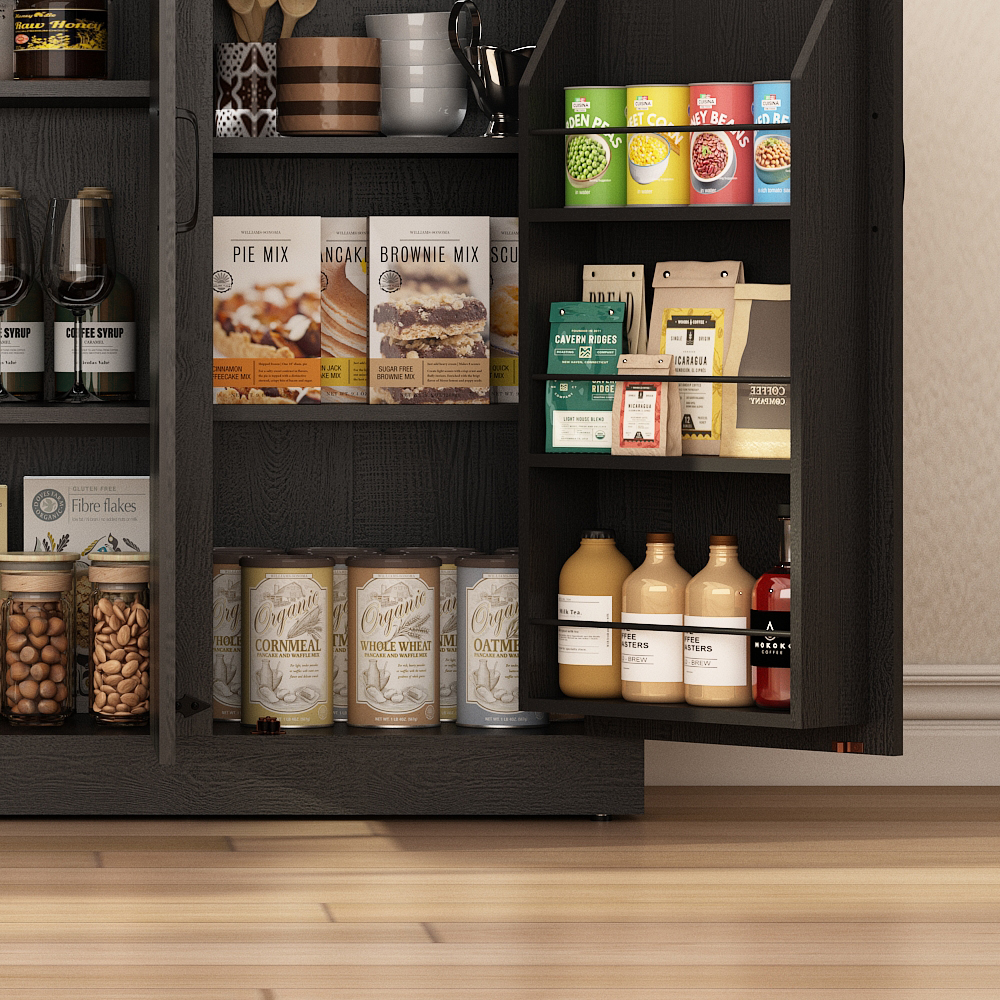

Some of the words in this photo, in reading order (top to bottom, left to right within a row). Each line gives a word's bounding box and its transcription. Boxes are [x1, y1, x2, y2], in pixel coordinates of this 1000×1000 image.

[15, 21, 45, 30] Raw
[49, 20, 103, 31] Honey
[628, 112, 644, 127] EET
[233, 246, 255, 263] PIE
[263, 246, 289, 263] MIX
[321, 246, 367, 263] NCAK
[380, 246, 446, 263] BROWNIE
[454, 246, 479, 263] MIX
[491, 246, 518, 263] SCU
[4, 327, 31, 338] SYRUP
[66, 327, 95, 338] COFEE
[97, 327, 124, 338] SYRUP
[554, 334, 586, 344] CAVERN
[588, 334, 617, 344] RIDGES
[33, 490, 50, 507] DOVES
[51, 491, 64, 506] FARM
[71, 497, 101, 513] Fibre
[103, 497, 137, 513] flakes
[35, 509, 63, 520] ORGANIC
[254, 589, 319, 637] Organic
[361, 589, 426, 637] Organic
[255, 639, 322, 652] CORNMEAL
[360, 640, 396, 652] WHOLE
[398, 640, 432, 652] WHEAT
